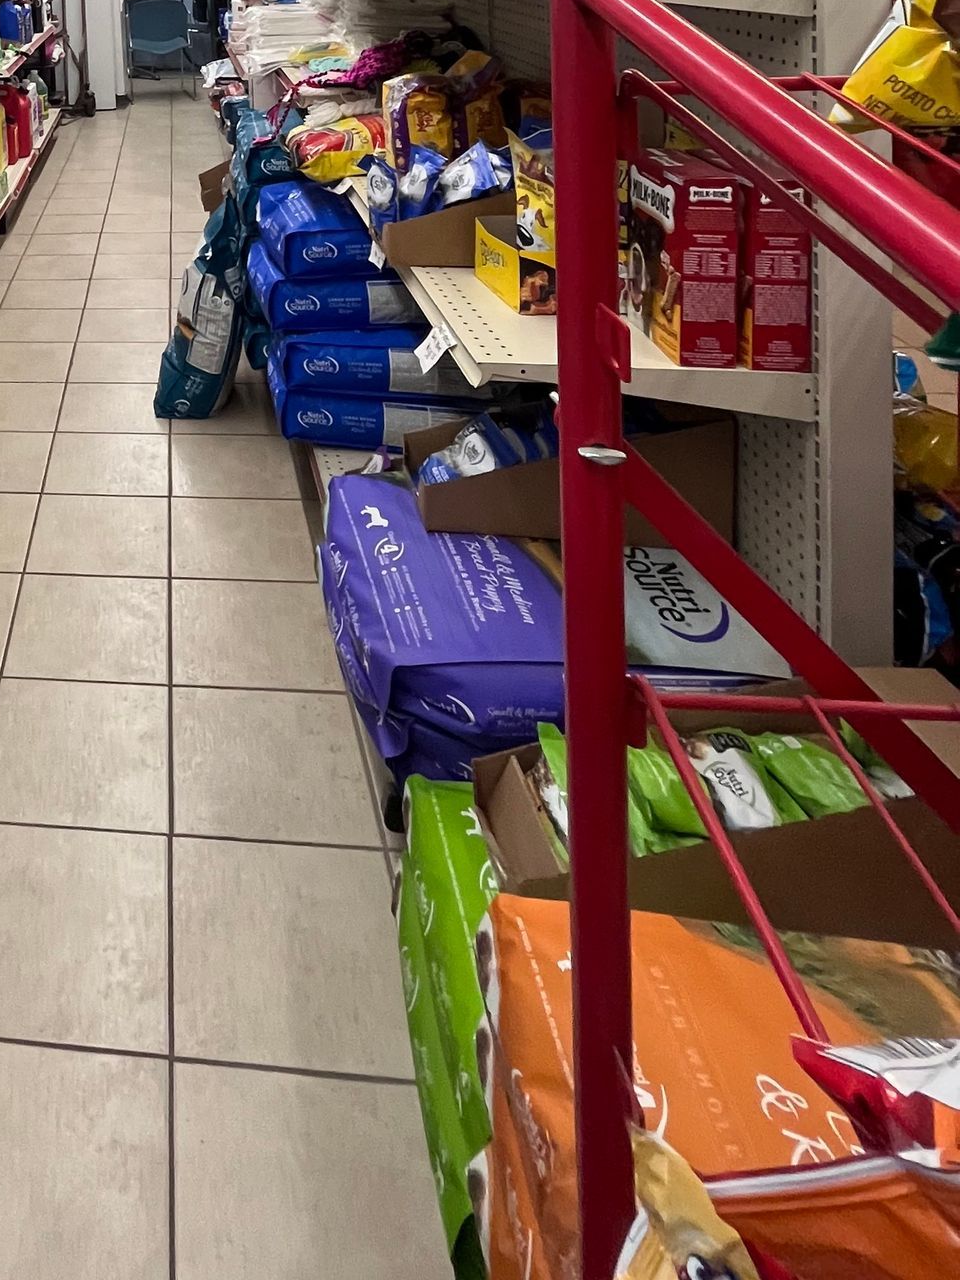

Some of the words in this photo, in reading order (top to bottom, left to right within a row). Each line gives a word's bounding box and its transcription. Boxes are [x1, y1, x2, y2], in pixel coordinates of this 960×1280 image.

[882, 74, 937, 112] POTATO
[632, 178, 671, 220] MILK-BONE
[692, 190, 730, 199] MILK-BONE
[461, 540, 495, 573] Breed
[480, 572, 507, 613] Puppy
[475, 535, 513, 564] Small
[503, 575, 535, 624] Medium
[624, 547, 686, 623] Source
[650, 561, 711, 614] Nutri
